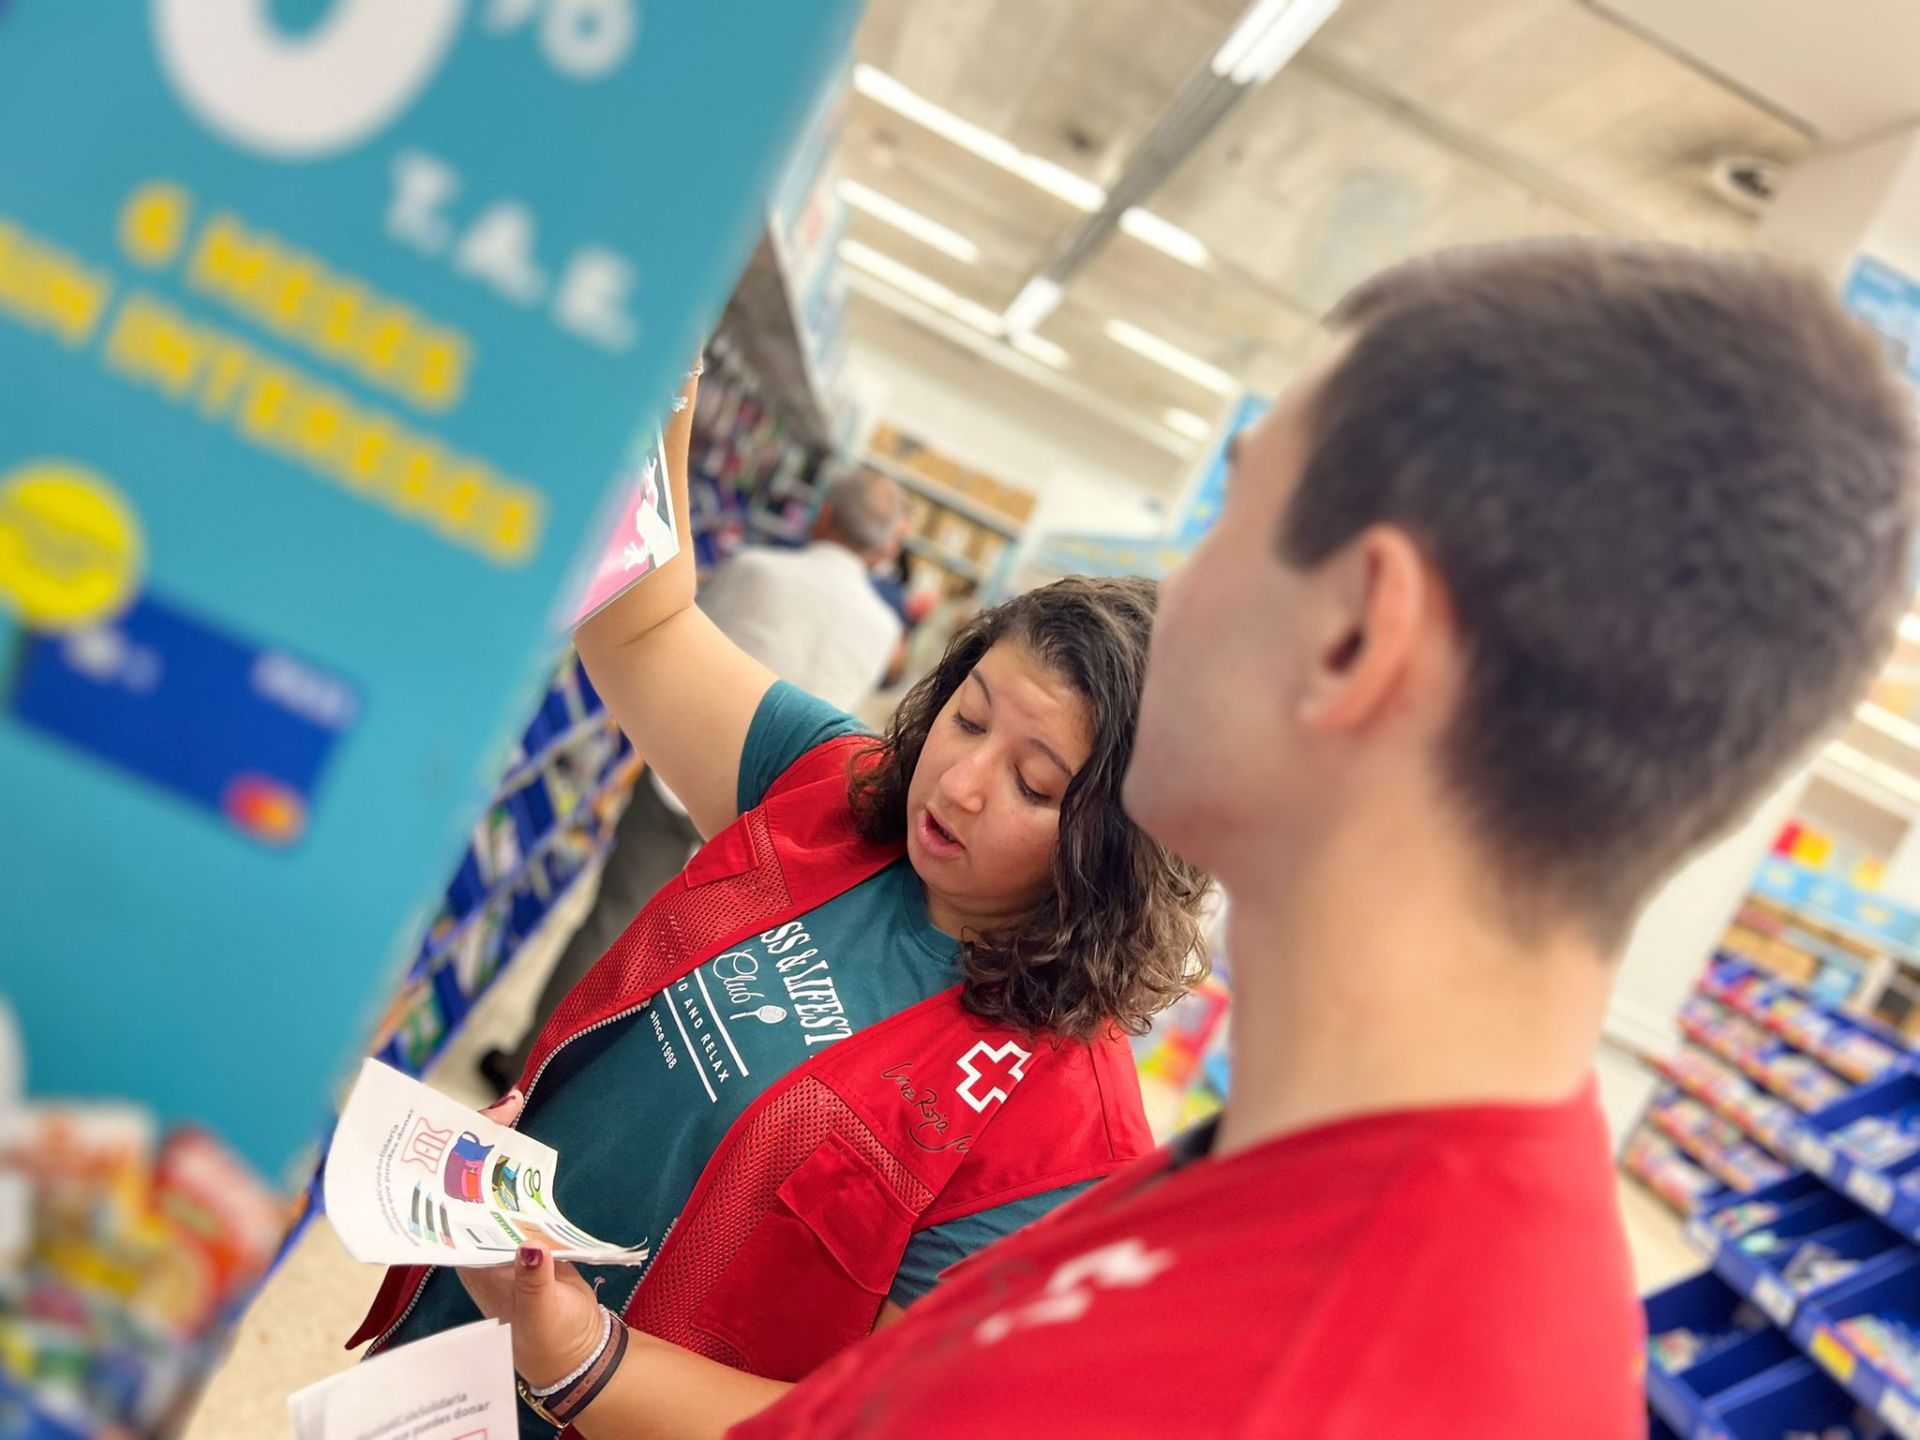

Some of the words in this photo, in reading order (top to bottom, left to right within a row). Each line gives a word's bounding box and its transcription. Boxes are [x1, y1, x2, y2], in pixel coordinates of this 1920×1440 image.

[193, 216, 472, 410] MESES
[713, 949, 765, 1004] Club
[775, 948, 818, 972] &
[650, 1010, 665, 1042] since
[661, 1041, 677, 1069] 1998
[783, 960, 853, 1048] LIFEST
[683, 998, 703, 1029] AND
[701, 1033, 729, 1083] RELAX
